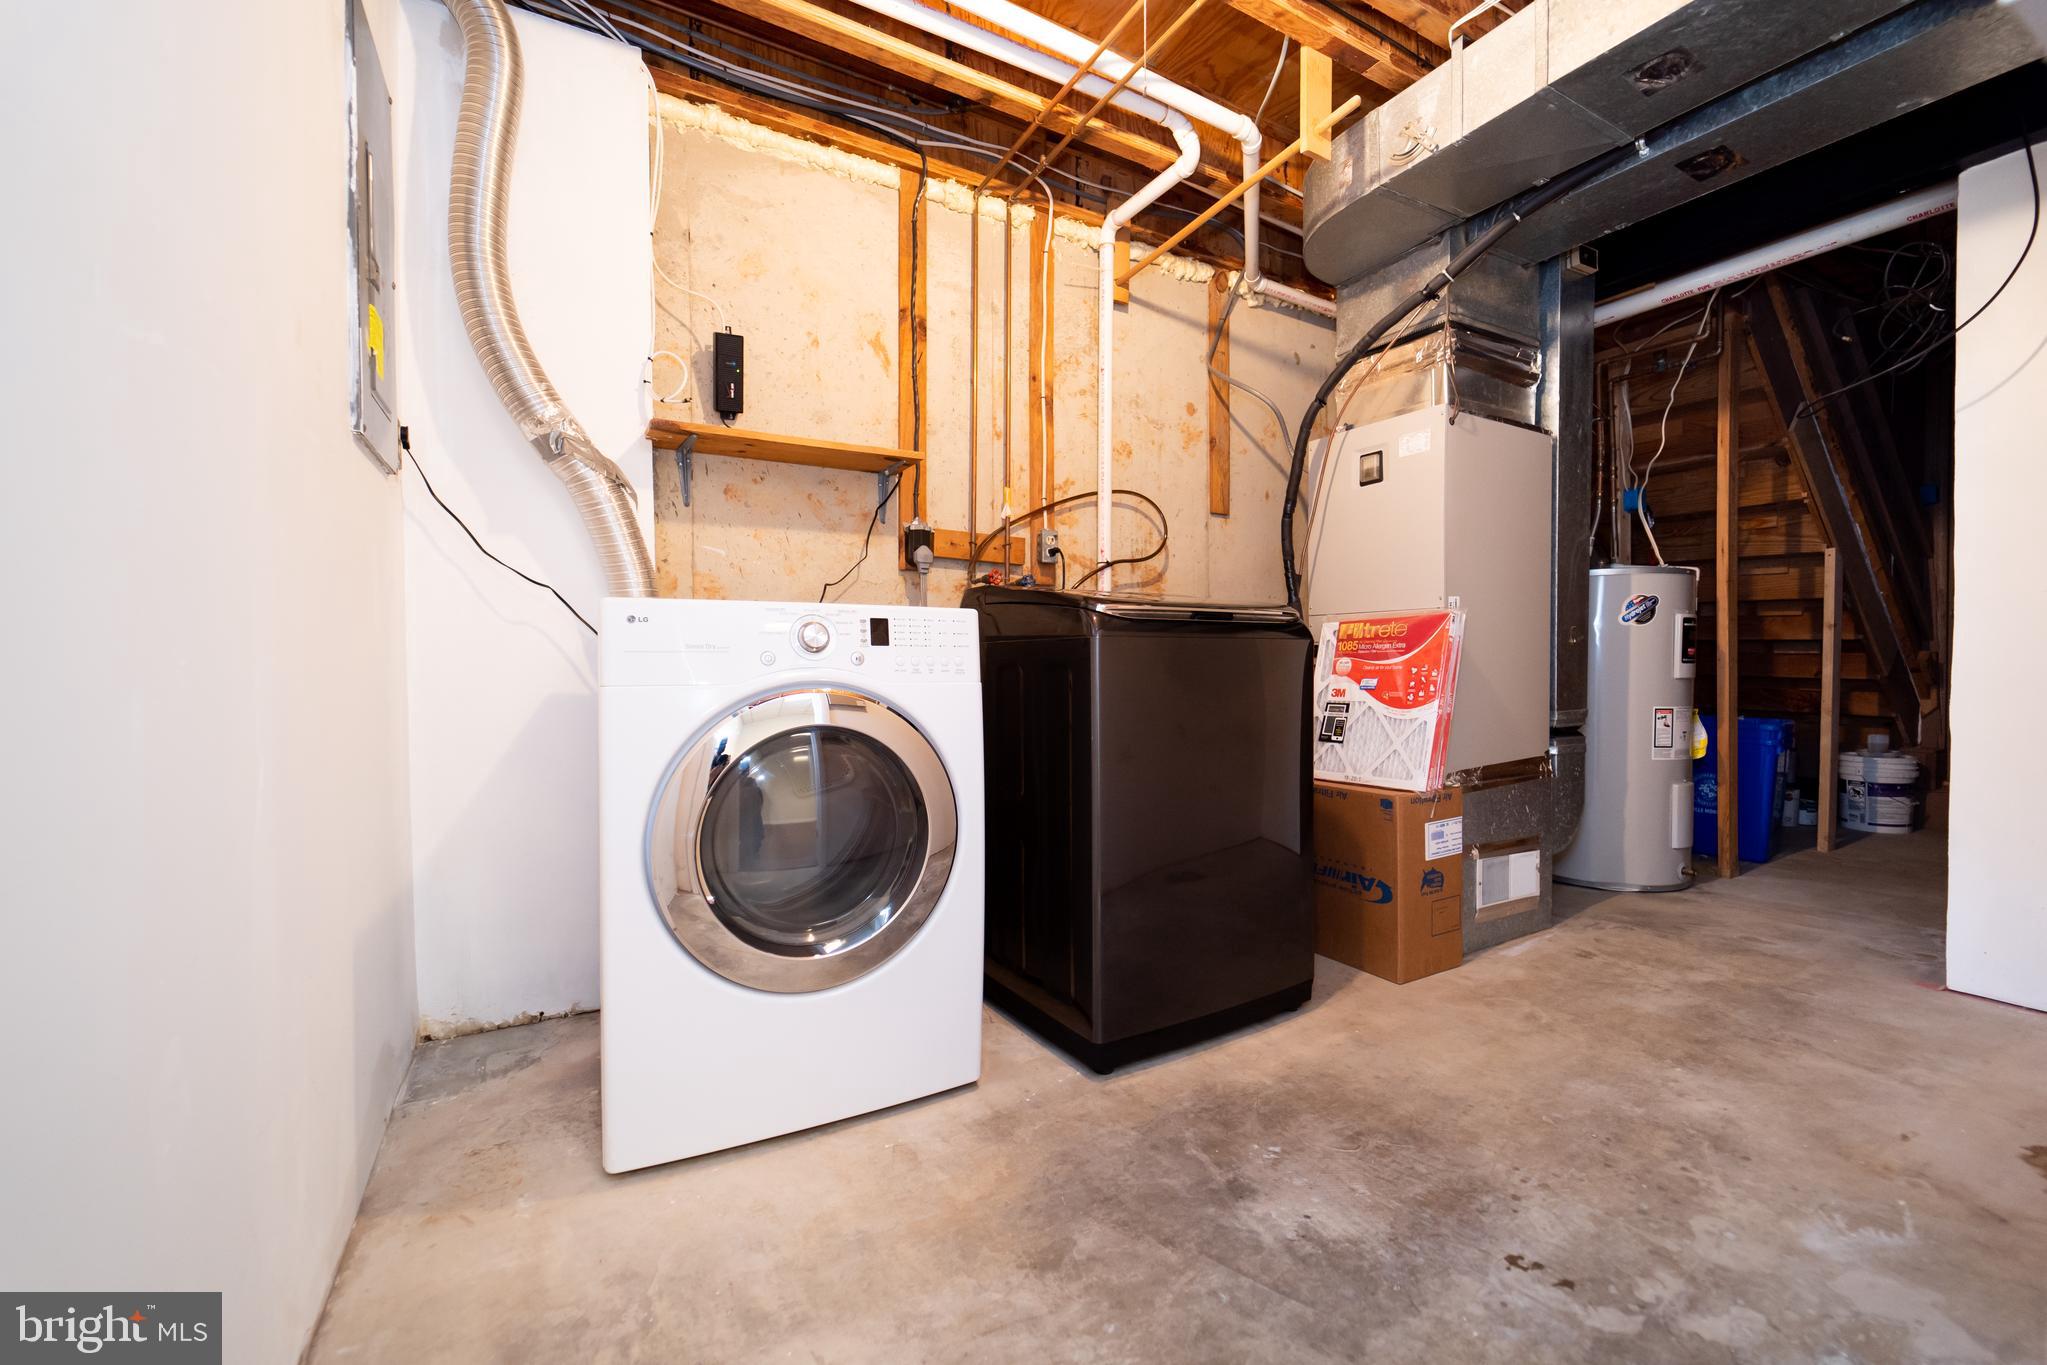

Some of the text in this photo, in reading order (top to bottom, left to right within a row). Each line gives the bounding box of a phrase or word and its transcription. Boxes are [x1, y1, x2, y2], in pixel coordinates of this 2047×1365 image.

[1906, 202, 1955, 222] CHARLOTTE
[1661, 284, 1712, 304] CHARLOTTE PIPE
[1339, 621, 1408, 639] Filtrete
[1338, 641, 1358, 651] 1085
[1392, 641, 1406, 650] Extra
[1331, 688, 1347, 697] 3M
[1336, 789, 1348, 800] Air
